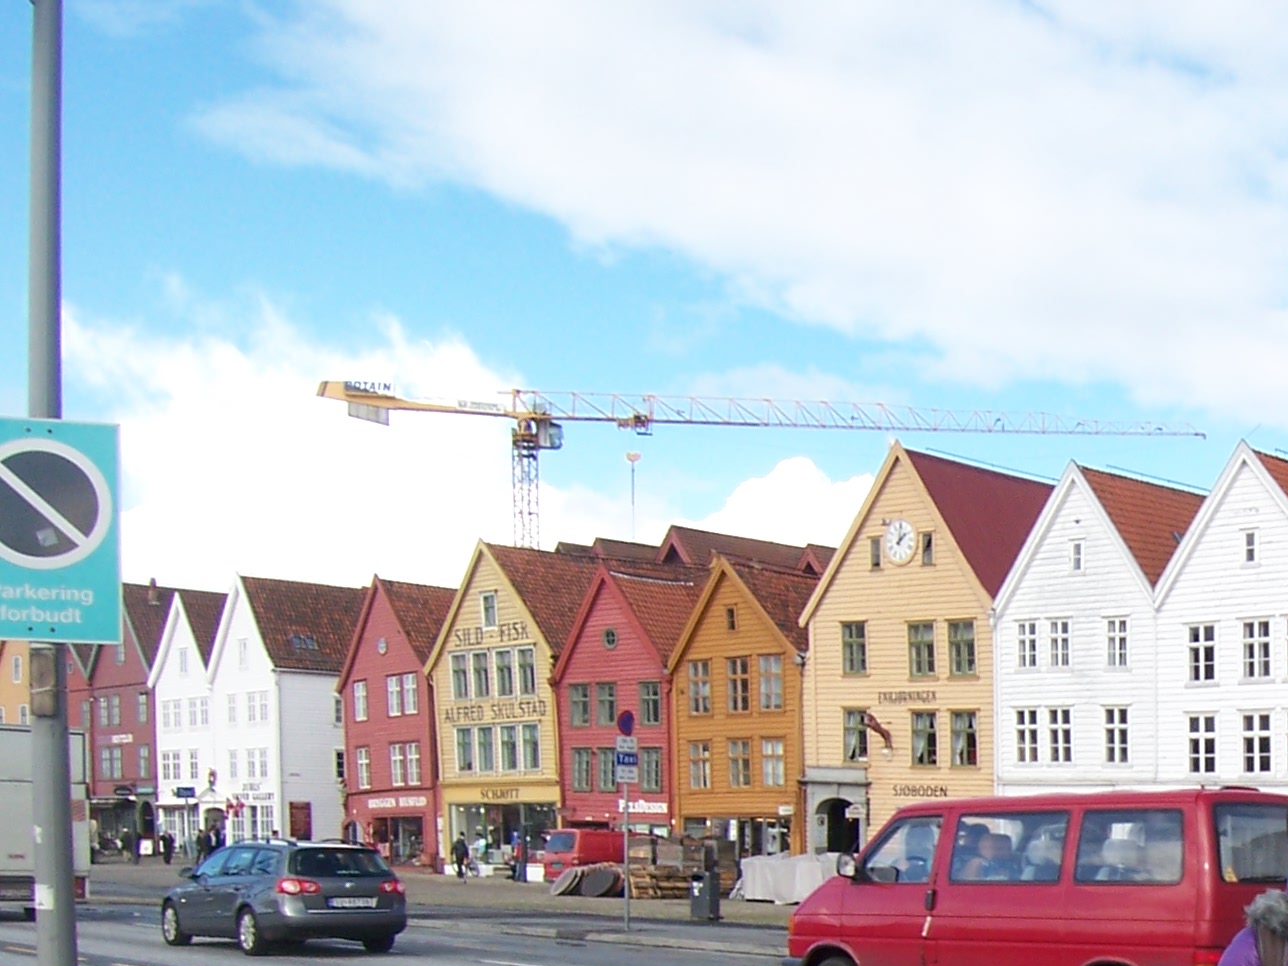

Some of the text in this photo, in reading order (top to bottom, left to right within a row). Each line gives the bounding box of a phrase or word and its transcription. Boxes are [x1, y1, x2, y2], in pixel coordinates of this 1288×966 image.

[0, 583, 94, 606] arkering
[454, 626, 484, 647] SILD
[500, 620, 529, 642] FISK
[444, 705, 484, 723] ALFRED
[618, 752, 638, 765] Taxi
